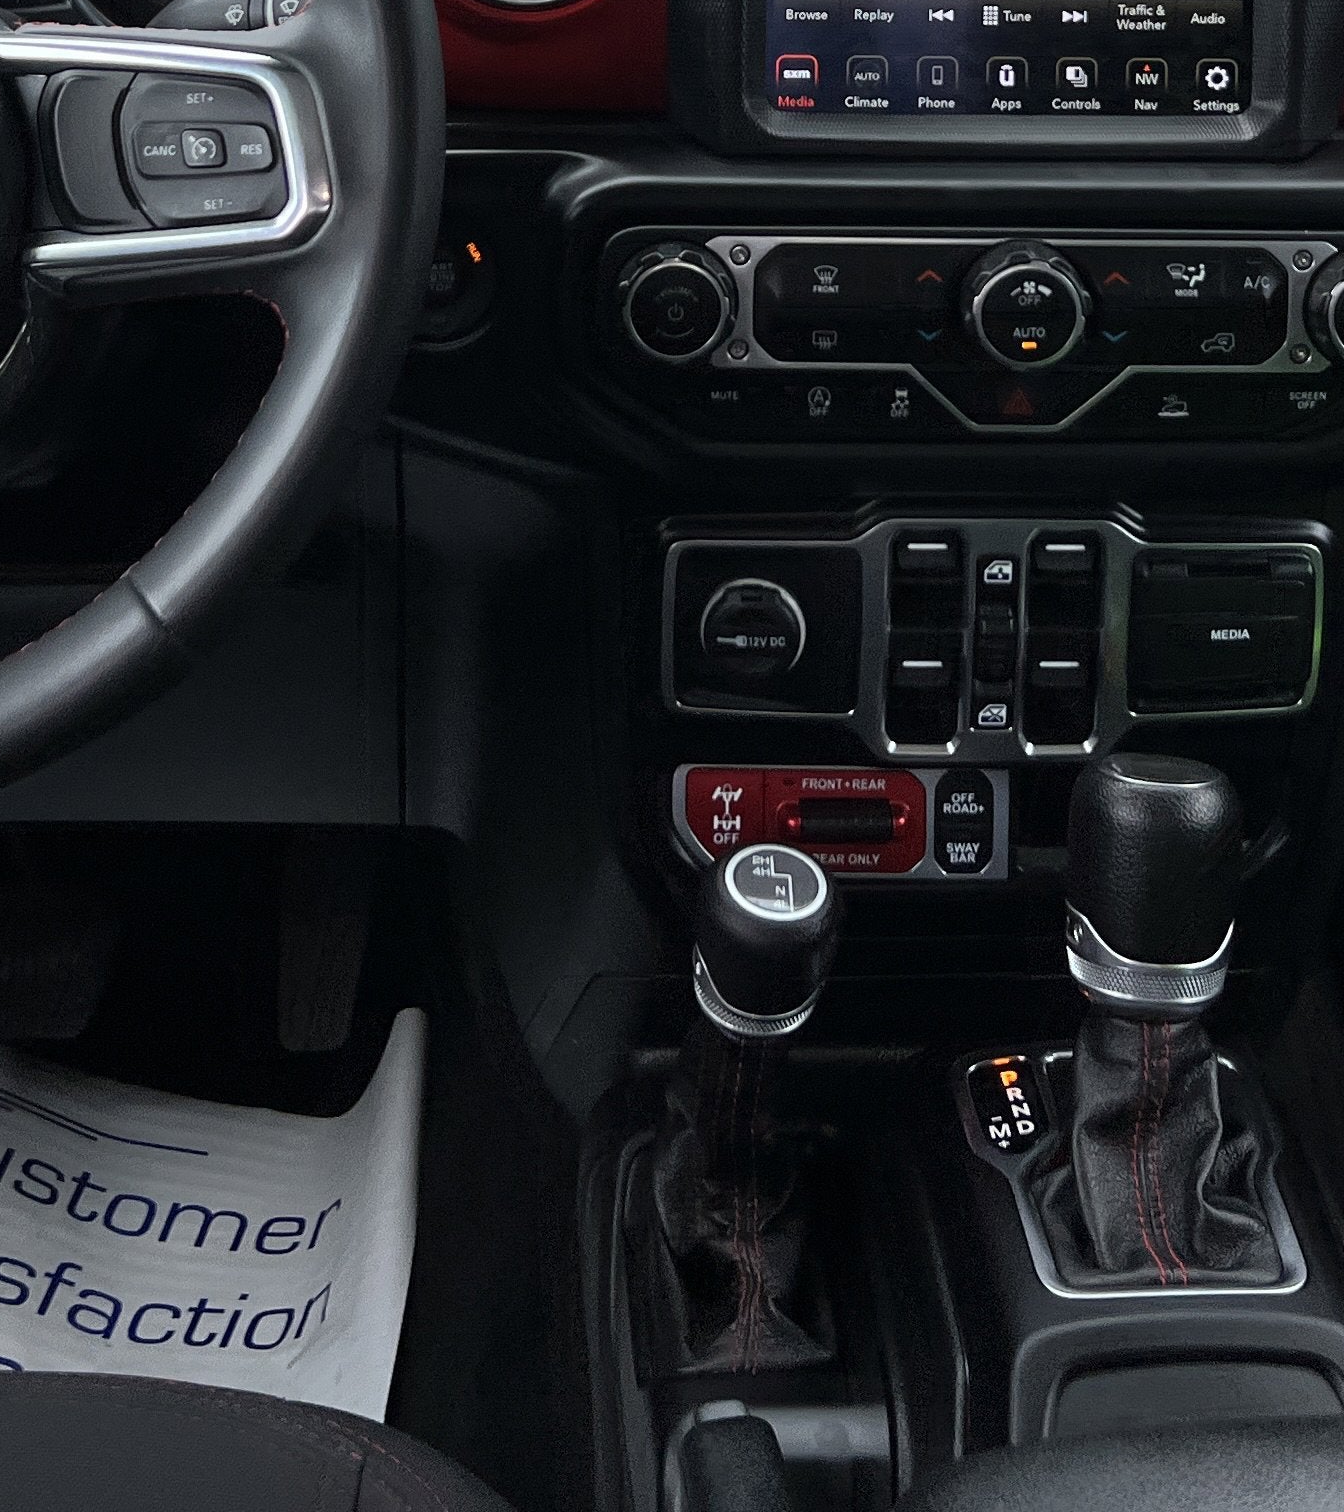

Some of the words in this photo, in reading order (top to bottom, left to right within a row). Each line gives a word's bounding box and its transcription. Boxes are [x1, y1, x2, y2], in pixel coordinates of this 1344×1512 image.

[785, 9, 828, 21] Browse
[854, 9, 894, 23] Replay
[1003, 10, 1032, 22] Tune
[1118, 4, 1153, 16] Traffic
[1156, 5, 1165, 16] &
[1116, 18, 1167, 31] Weather
[1190, 13, 1226, 25] Audio
[854, 72, 880, 81] AUTO
[1135, 73, 1159, 85] NW
[777, 96, 815, 107] Media
[844, 96, 889, 108] Climate
[918, 96, 955, 108] Phone
[991, 98, 1022, 110] Apps
[1051, 98, 1101, 110] Controls
[1134, 99, 1158, 110] Nav
[1193, 100, 1240, 112] Settings
[143, 145, 177, 156] CANC
[240, 144, 263, 155] RES
[1244, 275, 1271, 289] A/C
[812, 285, 839, 293] FRONT
[1174, 289, 1198, 297] MODE
[1018, 296, 1041, 306] OFF
[1013, 327, 1045, 338] AUTO
[710, 391, 739, 400] MUTE
[1289, 391, 1327, 400] SCREEN
[1297, 400, 1316, 409] OFF
[809, 407, 828, 416] OFF
[891, 408, 908, 417] OFF
[1210, 628, 1250, 640] MEDIA
[749, 636, 768, 647] 12V
[770, 636, 786, 646] DC
[952, 793, 975, 803] OFF
[713, 832, 740, 844] OFF
[946, 842, 980, 854] SWAY
[848, 854, 881, 866] ONLY
[950, 852, 976, 864] BAR
[752, 867, 771, 877] 4H
[775, 886, 785, 896] N
[1000, 1070, 1018, 1086] P
[1006, 1087, 1026, 1102] R
[1012, 1103, 1033, 1118] N
[989, 1123, 1011, 1140] M
[1016, 1119, 1035, 1135] D
